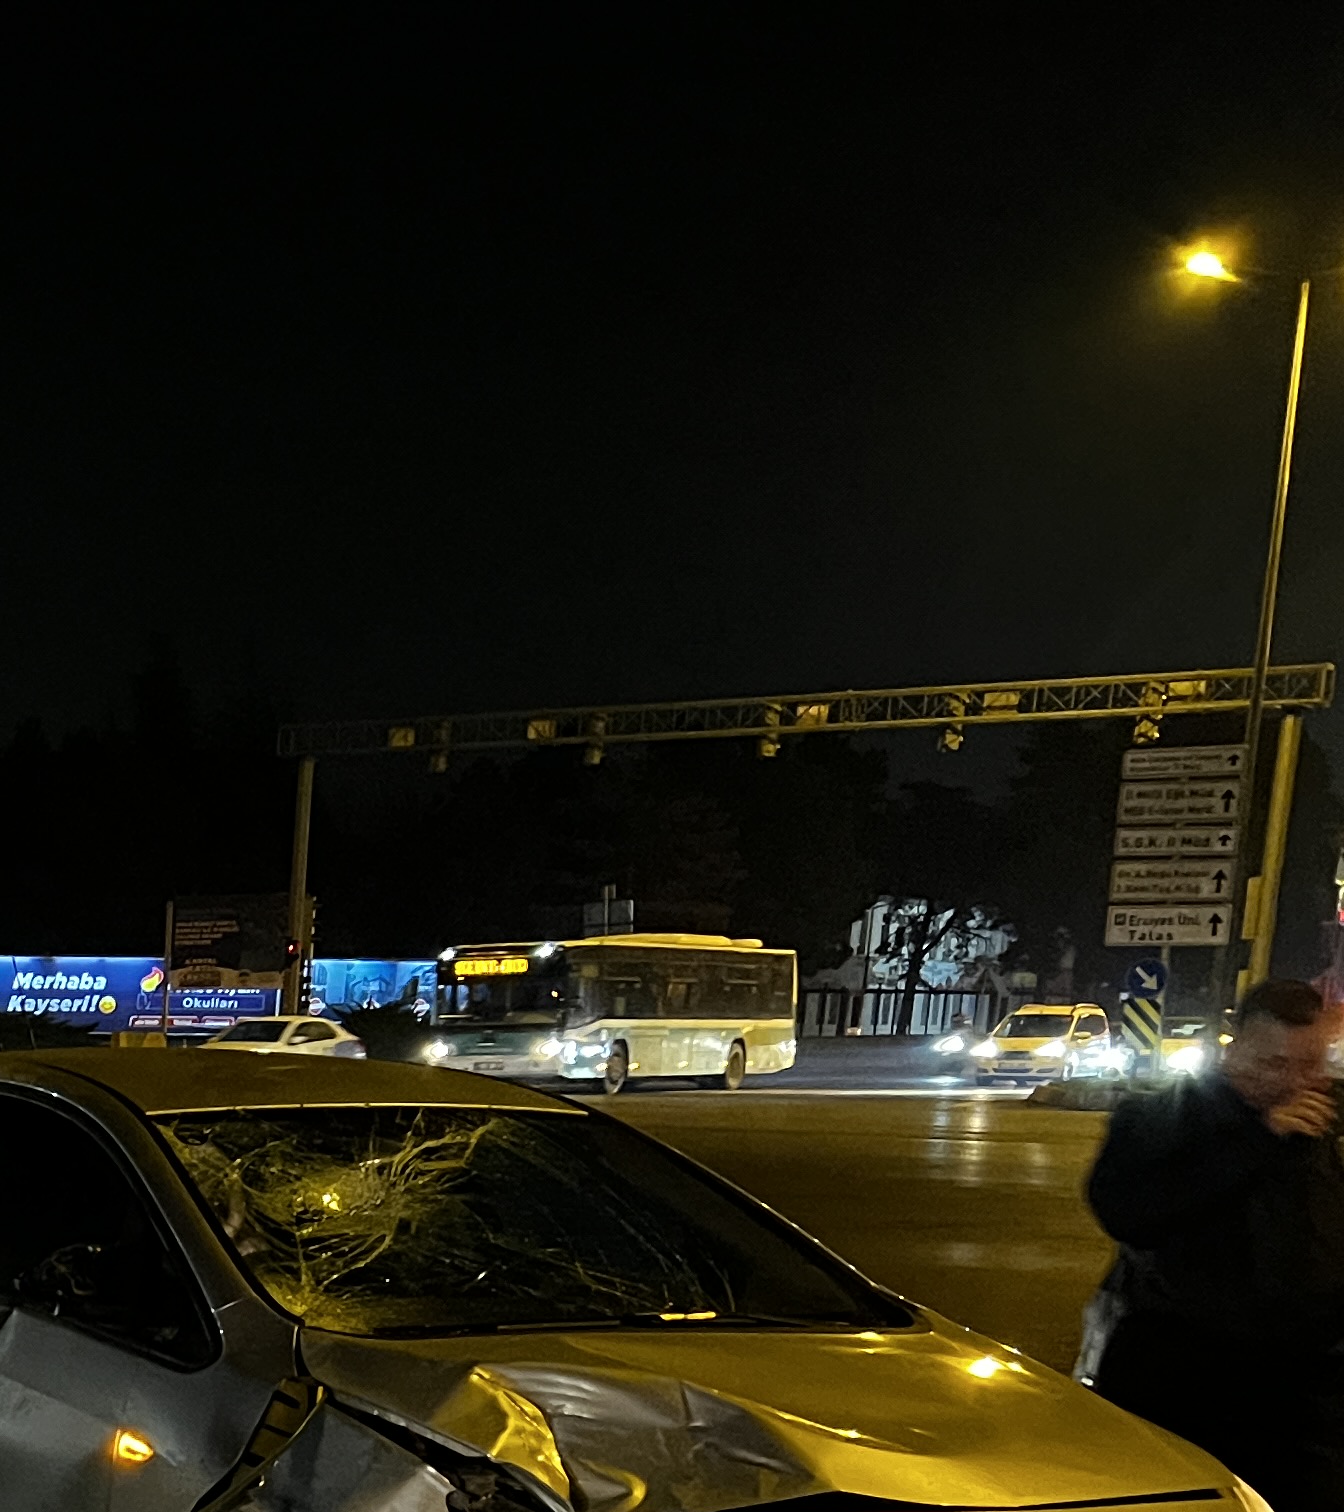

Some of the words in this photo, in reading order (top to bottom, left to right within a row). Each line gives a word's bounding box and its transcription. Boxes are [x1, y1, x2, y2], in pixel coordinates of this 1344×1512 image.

[1128, 929, 1174, 941] Talas
[12, 971, 108, 991] Merhaba
[6, 994, 98, 1017] Kayseri!
[182, 996, 239, 1009] Okulları
